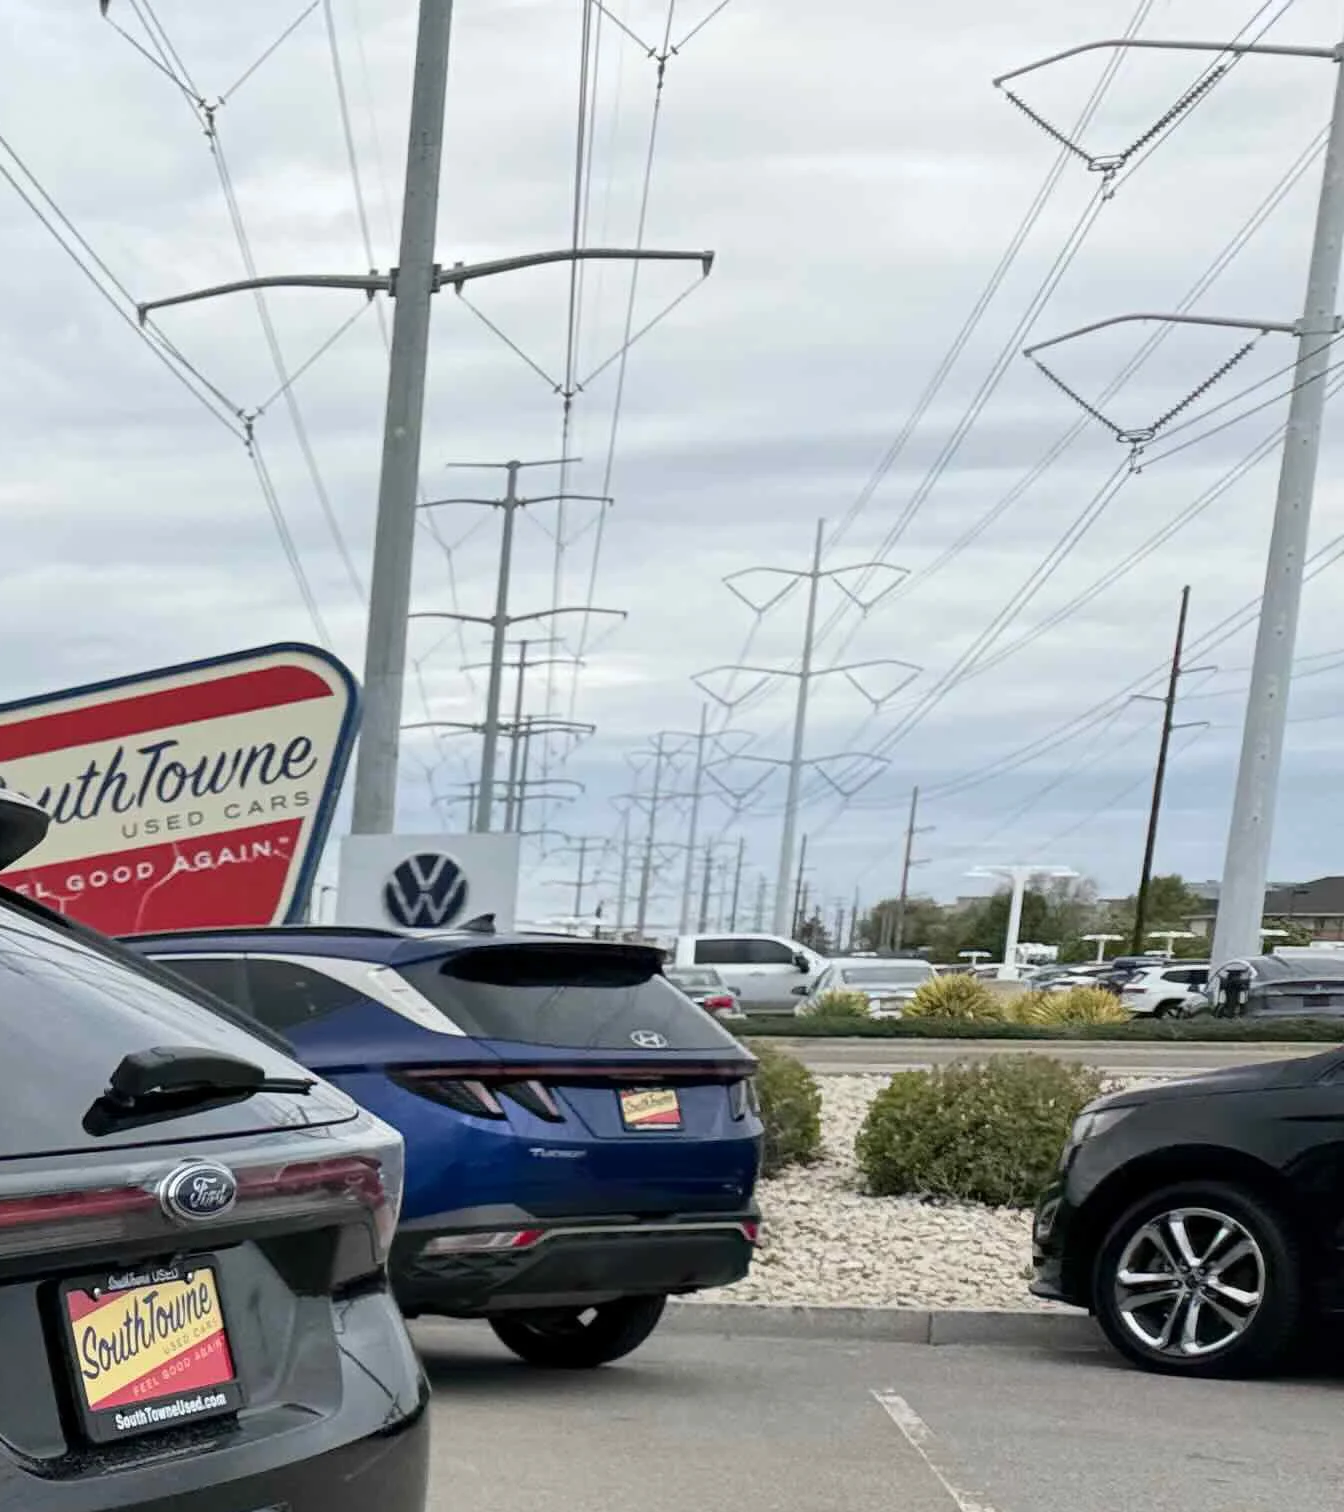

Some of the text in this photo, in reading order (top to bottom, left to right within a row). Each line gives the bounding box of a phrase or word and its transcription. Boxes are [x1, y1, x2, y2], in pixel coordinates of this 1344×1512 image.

[121, 791, 310, 839] USED CARS
[66, 862, 154, 891] GOOD
[83, 1282, 212, 1379] SouthTowne
[133, 1377, 160, 1396] FEEL
[161, 1357, 192, 1380] GOOD
[115, 1393, 227, 1430] SouthTowneUsed.com
